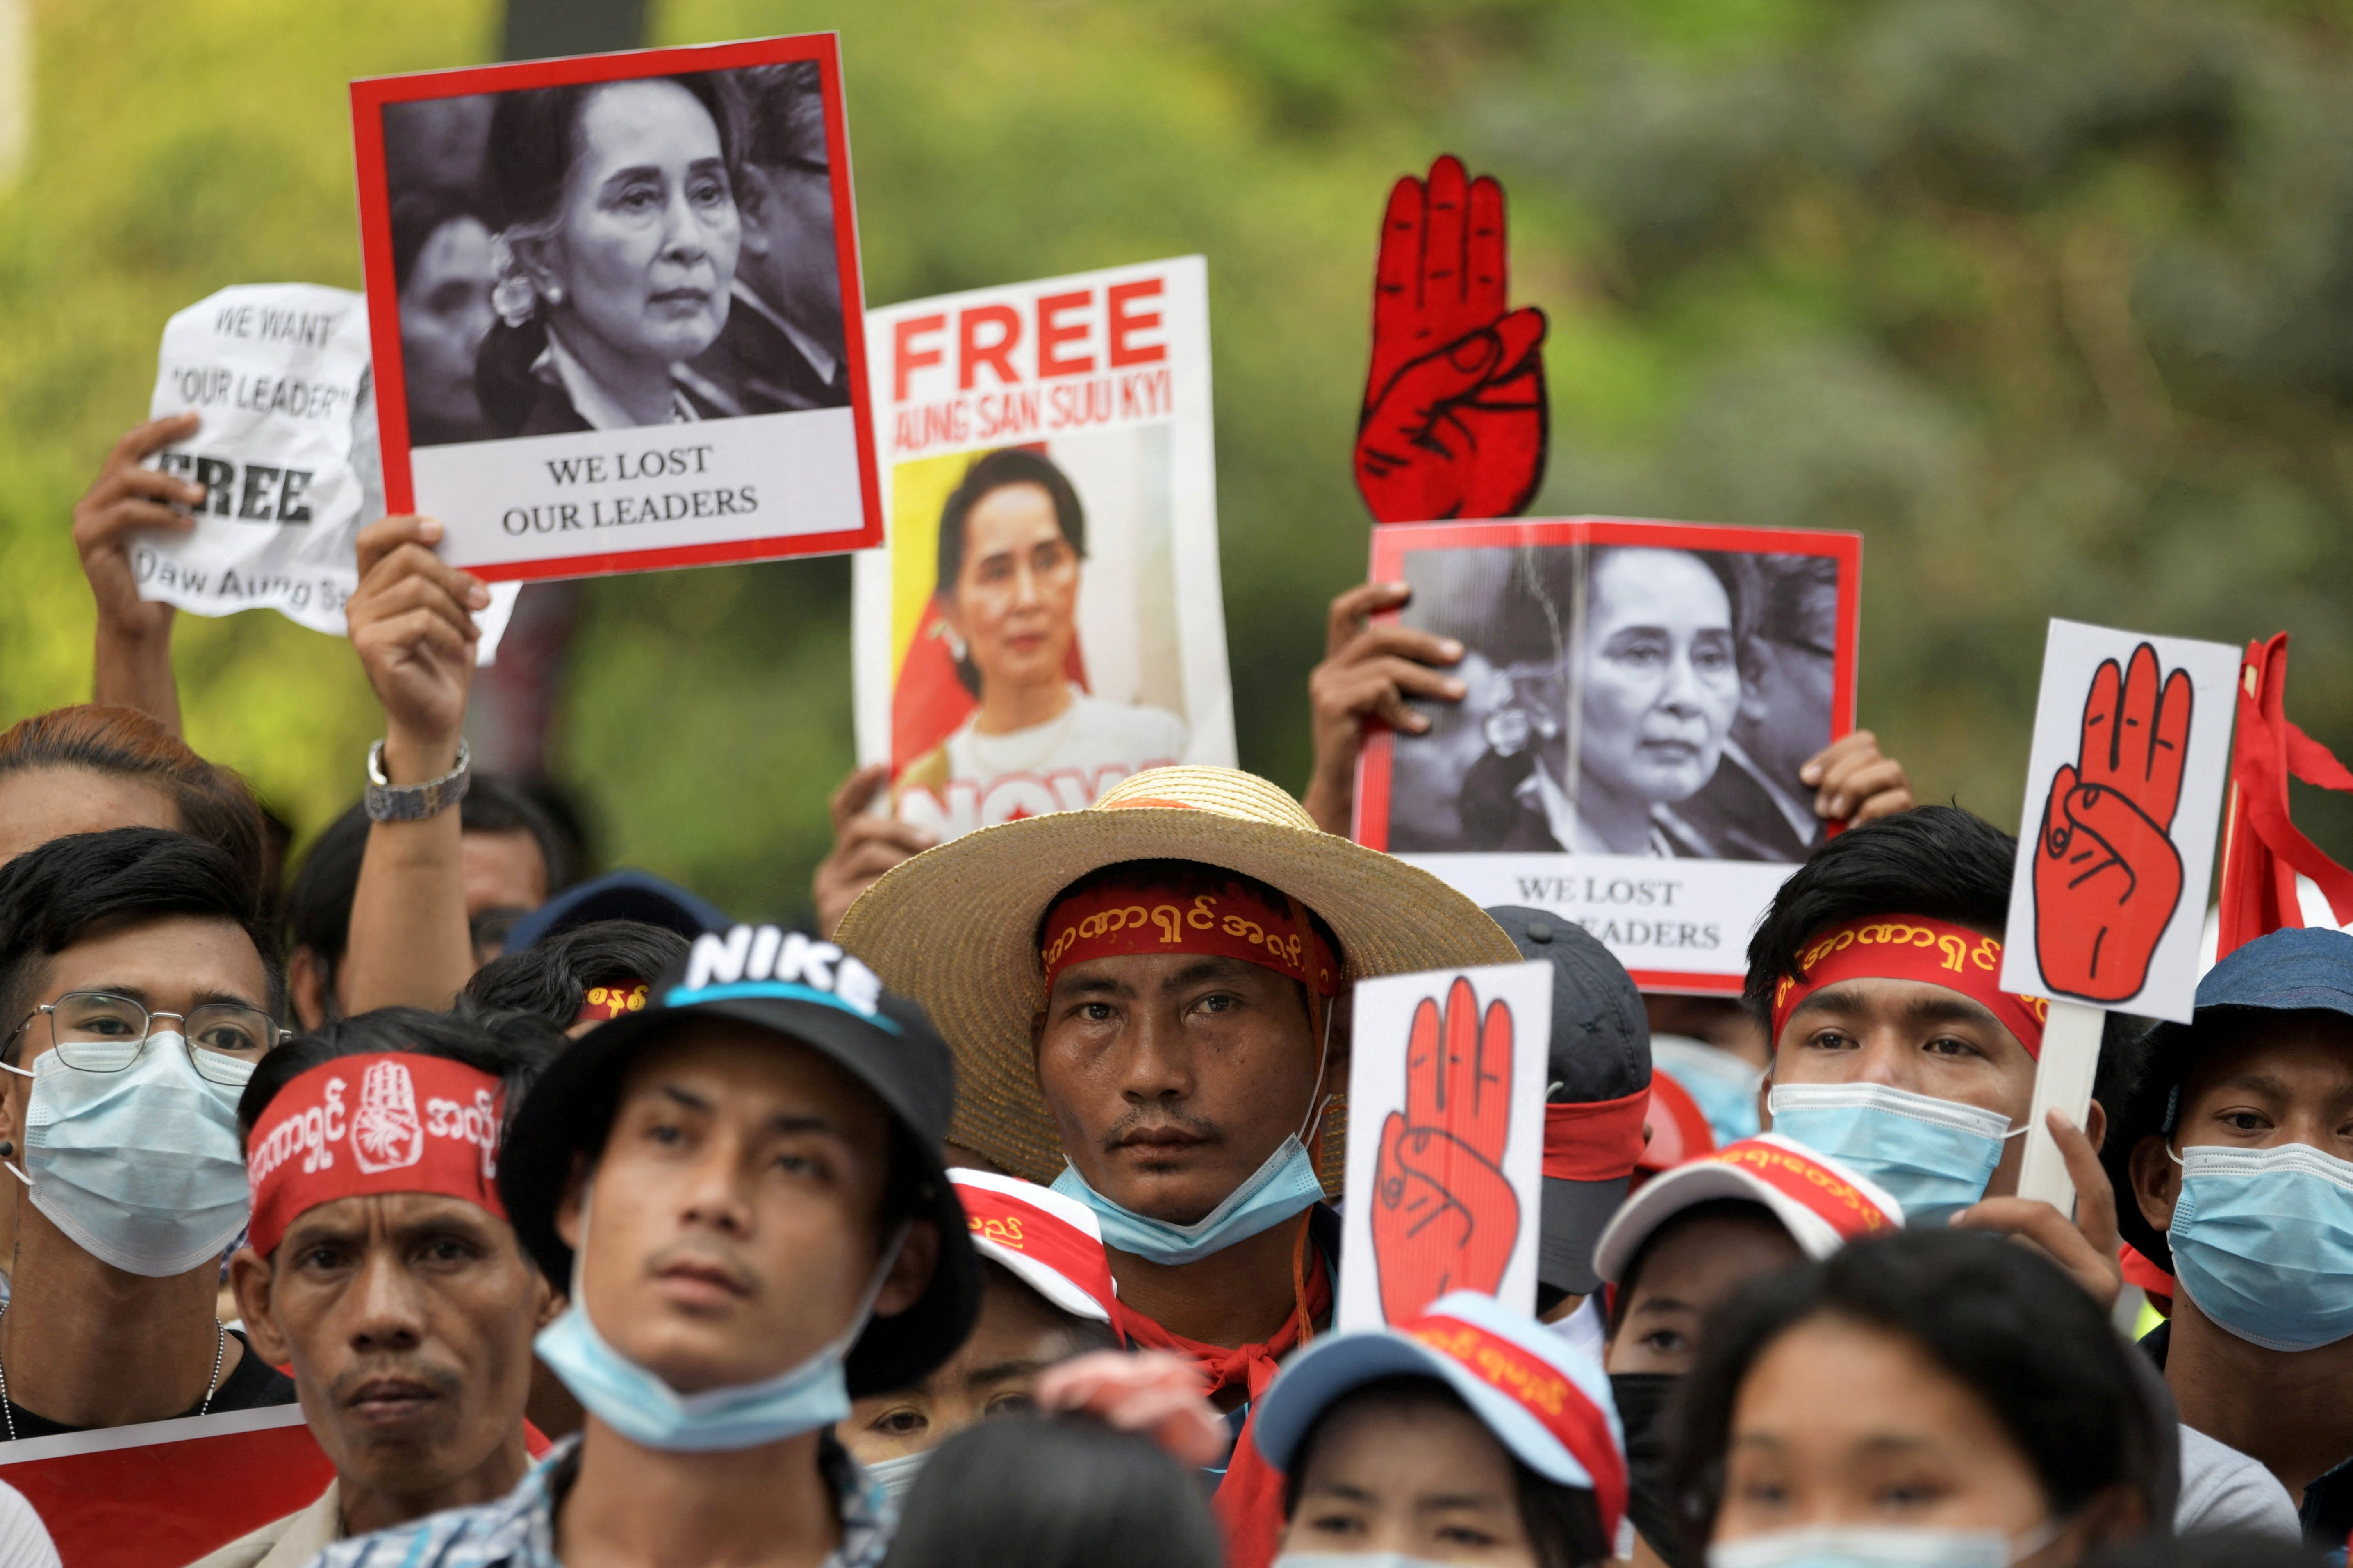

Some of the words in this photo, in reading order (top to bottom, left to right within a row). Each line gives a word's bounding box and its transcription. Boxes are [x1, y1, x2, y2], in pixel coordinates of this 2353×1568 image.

[216, 306, 253, 339] WE
[260, 309, 334, 348] WANT
[893, 277, 1167, 402] FREE
[894, 400, 969, 450] AUNG
[979, 388, 1039, 439] SAN
[1049, 380, 1113, 429] SUU
[1121, 369, 1171, 421] KYI
[545, 455, 608, 486] WE
[614, 445, 714, 482] LOST
[503, 504, 584, 536] OUR
[591, 485, 759, 529] LEADERS
[137, 547, 207, 593] Daw
[219, 566, 312, 611] Aung
[1516, 877, 1576, 902] WE
[1585, 877, 1683, 907] LOST
[685, 924, 882, 1017] NIKE
